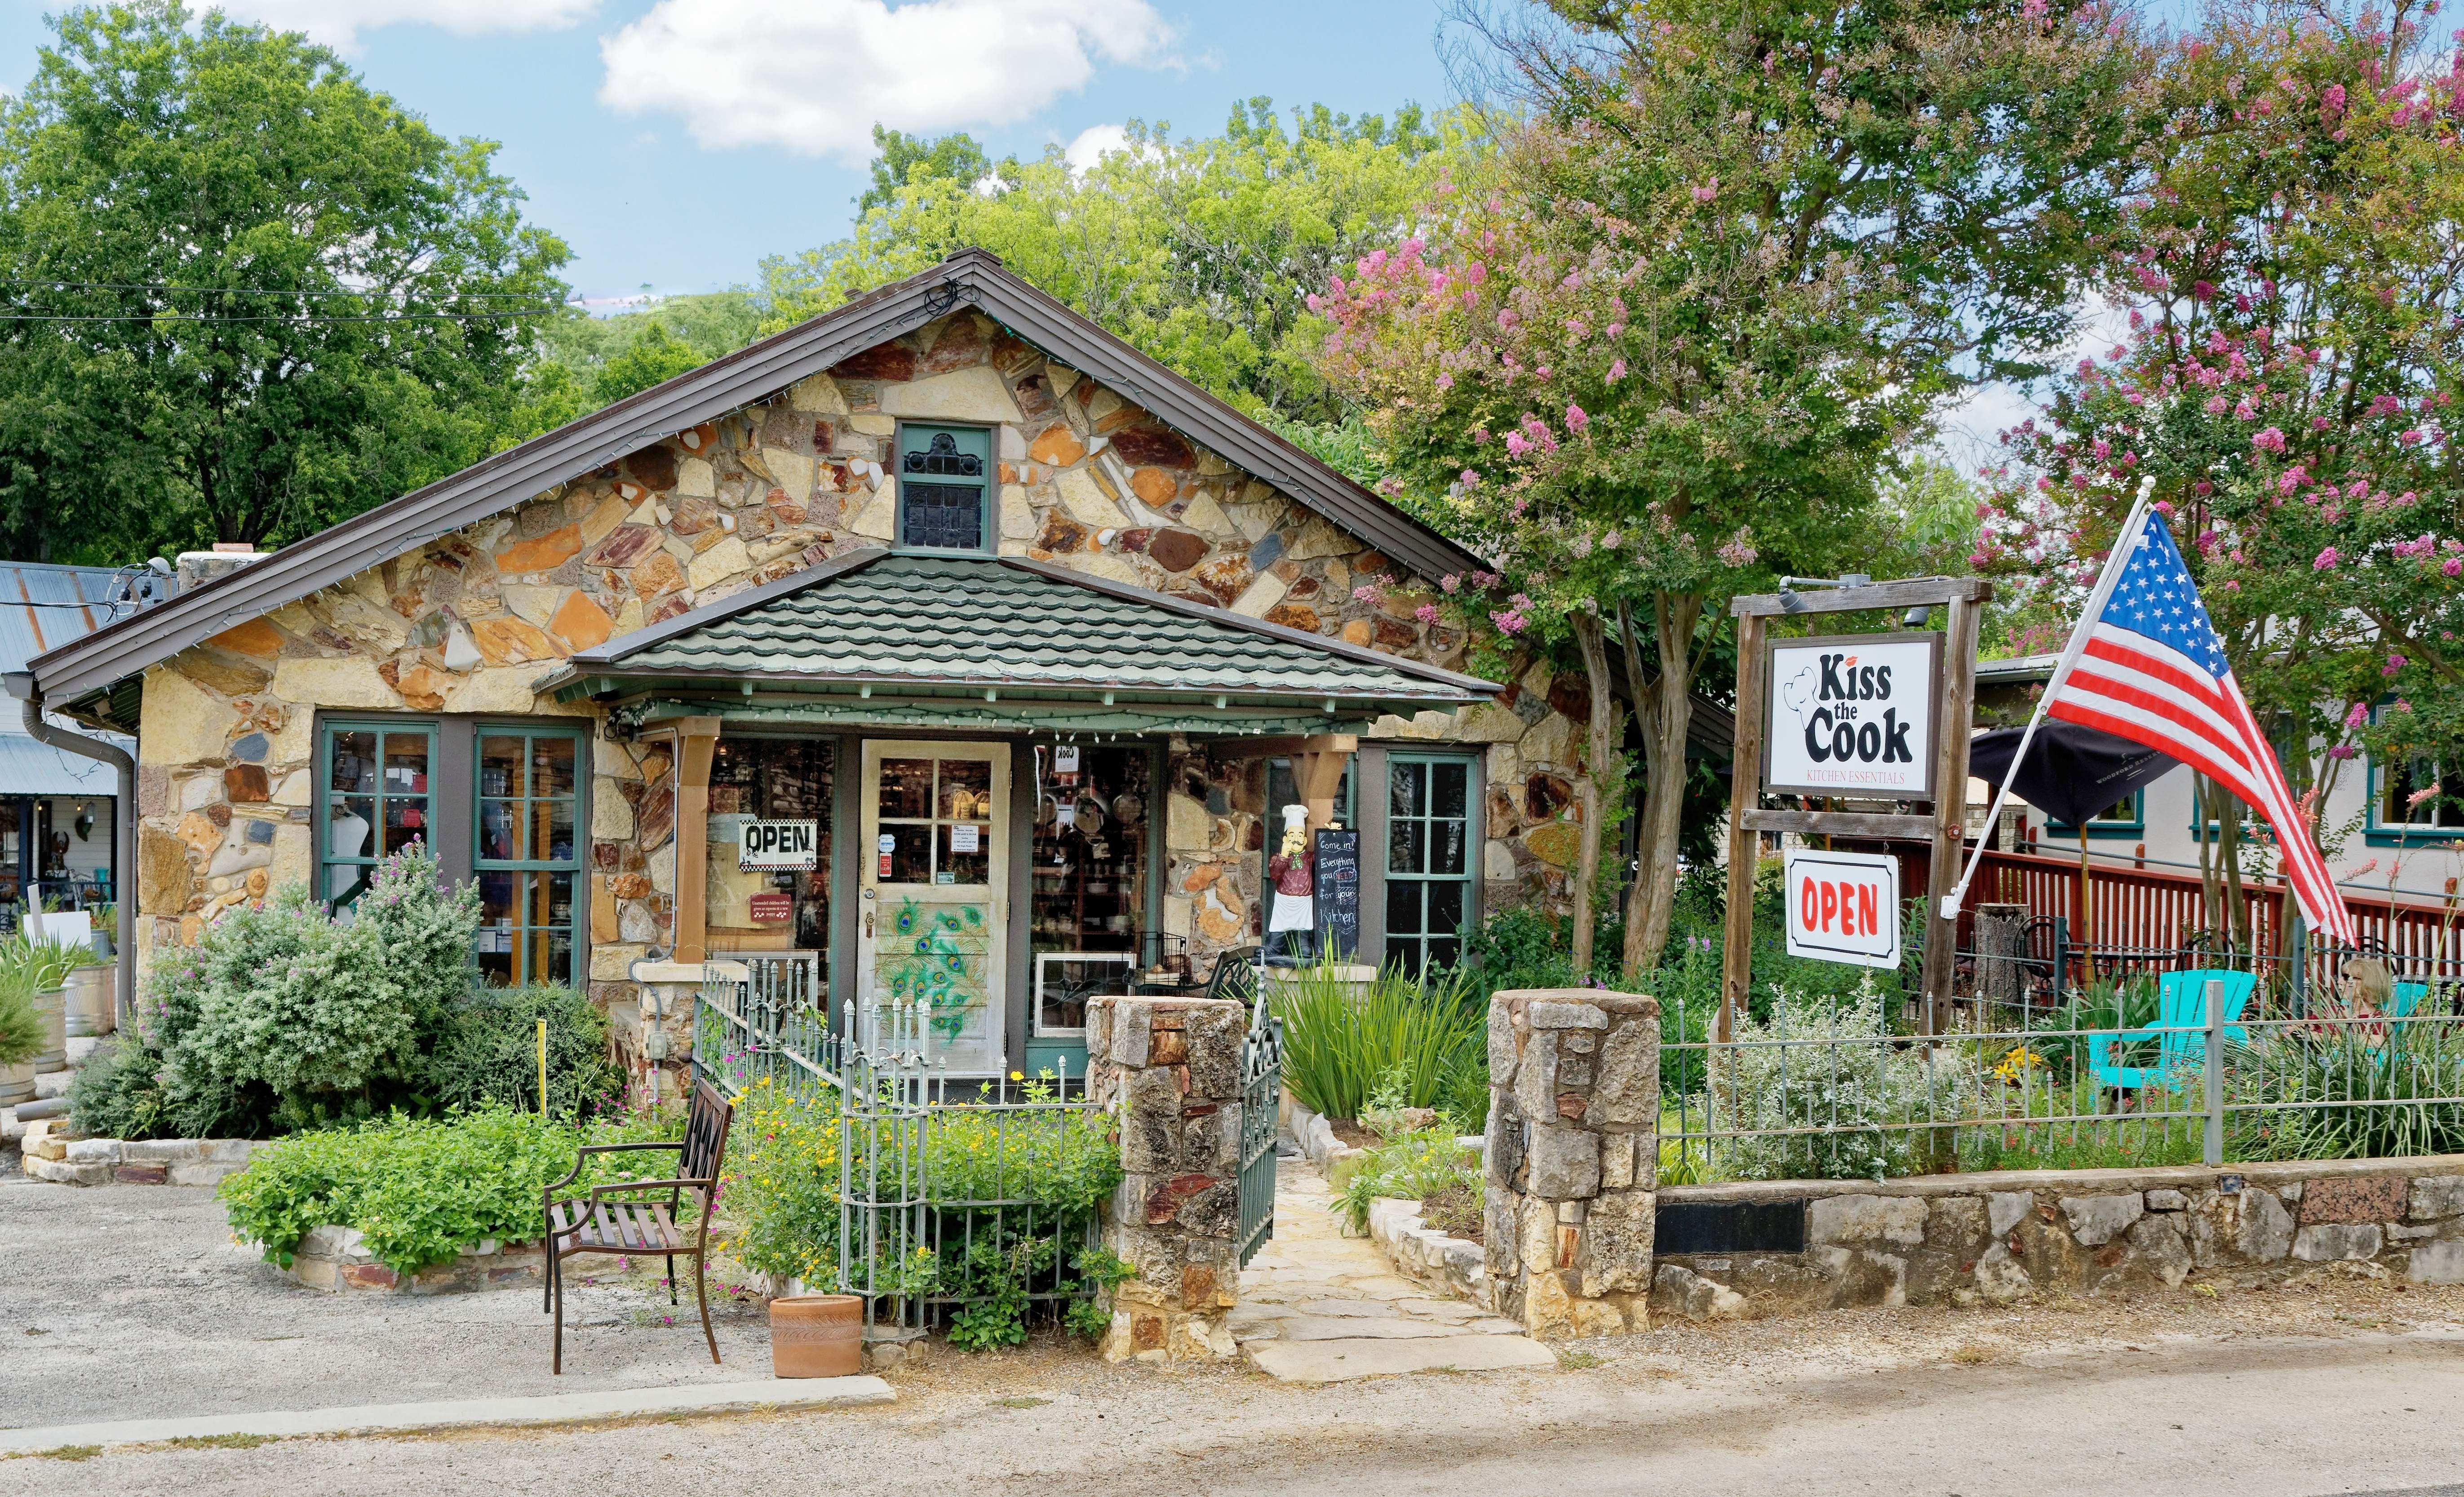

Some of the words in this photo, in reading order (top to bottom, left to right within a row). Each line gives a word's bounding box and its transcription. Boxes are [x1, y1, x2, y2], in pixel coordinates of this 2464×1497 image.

[1819, 654, 1892, 701] Kiss
[1834, 702, 1858, 720] the
[1805, 706, 1913, 763] Cook
[1807, 770, 1846, 782] KITCHEN
[1849, 771, 1905, 784] ESSENTIALS
[2096, 764, 2133, 784] WOODFORD
[746, 826, 810, 853] OPEN
[1321, 840, 1341, 849] Come
[1343, 840, 1354, 850] in!
[1321, 857, 1355, 872] Everything
[1321, 872, 1333, 884] you
[1335, 871, 1353, 880] NEED
[1320, 888, 1333, 900] for
[1338, 891, 1354, 904] your
[1802, 876, 1878, 937] OPEN
[1320, 907, 1356, 925] Kitchen
